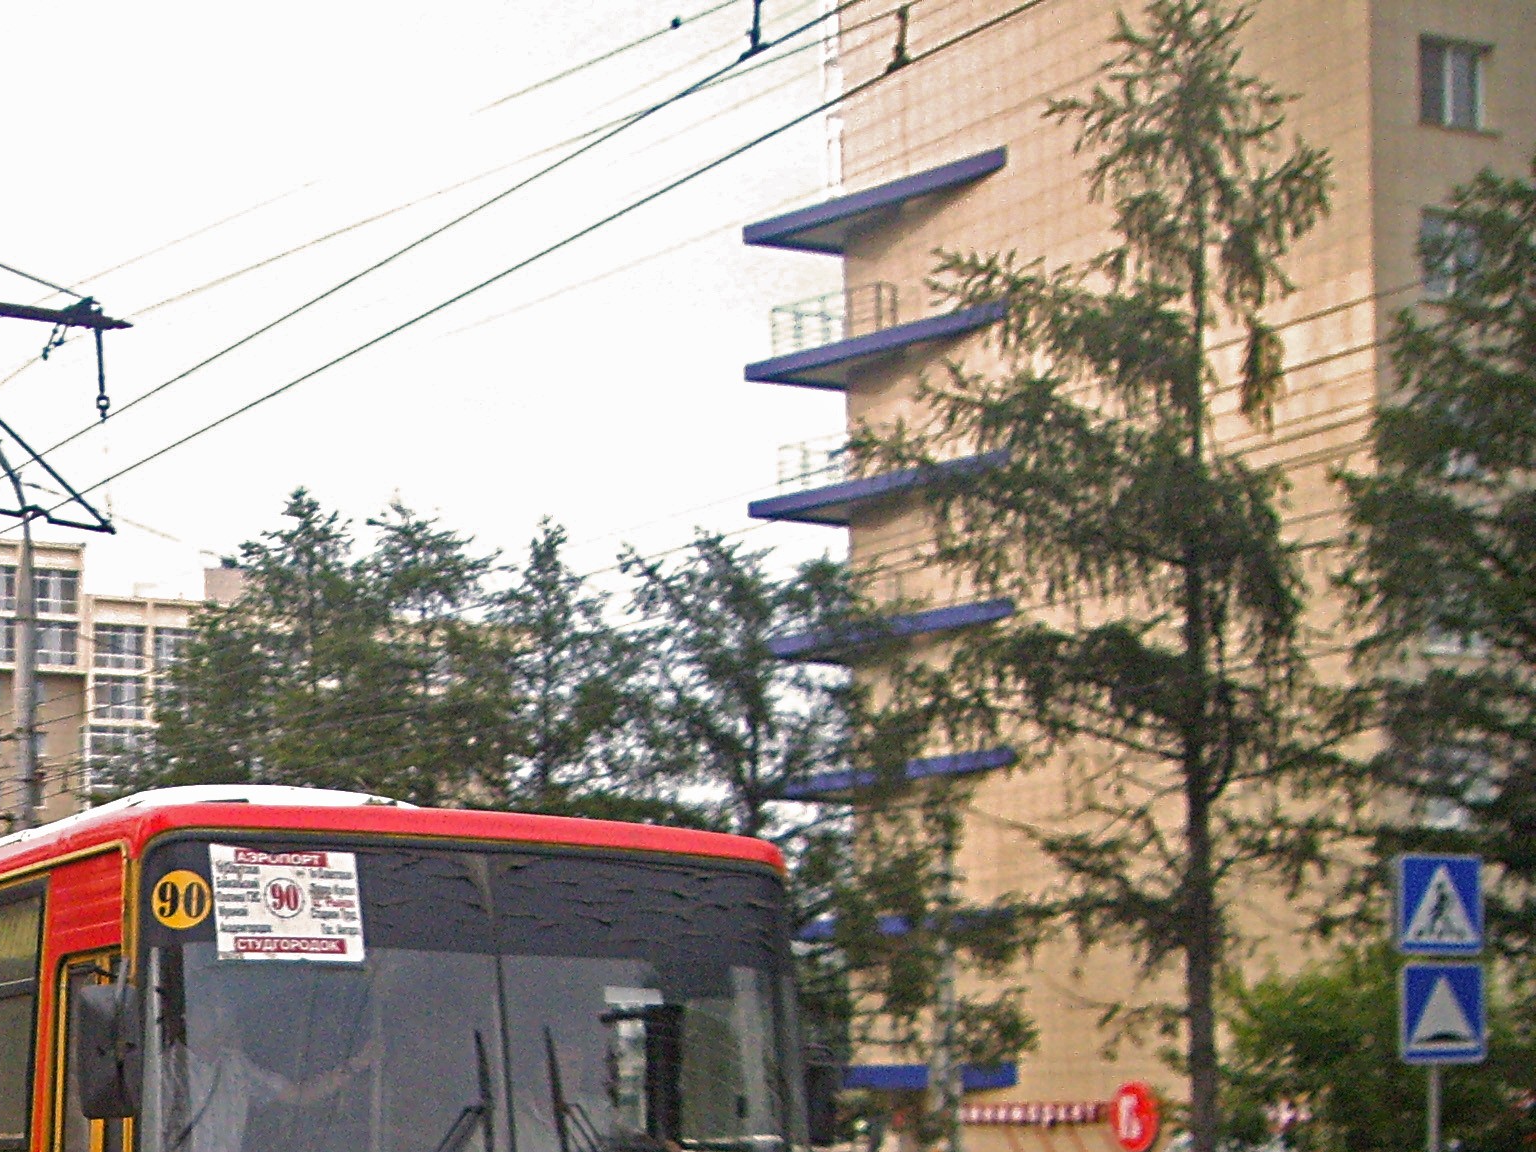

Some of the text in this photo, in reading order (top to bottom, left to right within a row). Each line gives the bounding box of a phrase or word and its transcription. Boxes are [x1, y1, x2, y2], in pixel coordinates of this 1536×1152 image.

[237, 851, 321, 866] АЭРОПОРТ
[158, 881, 207, 918] 90
[270, 883, 300, 911] 90
[236, 938, 340, 952] СТУДГОРОДОК
